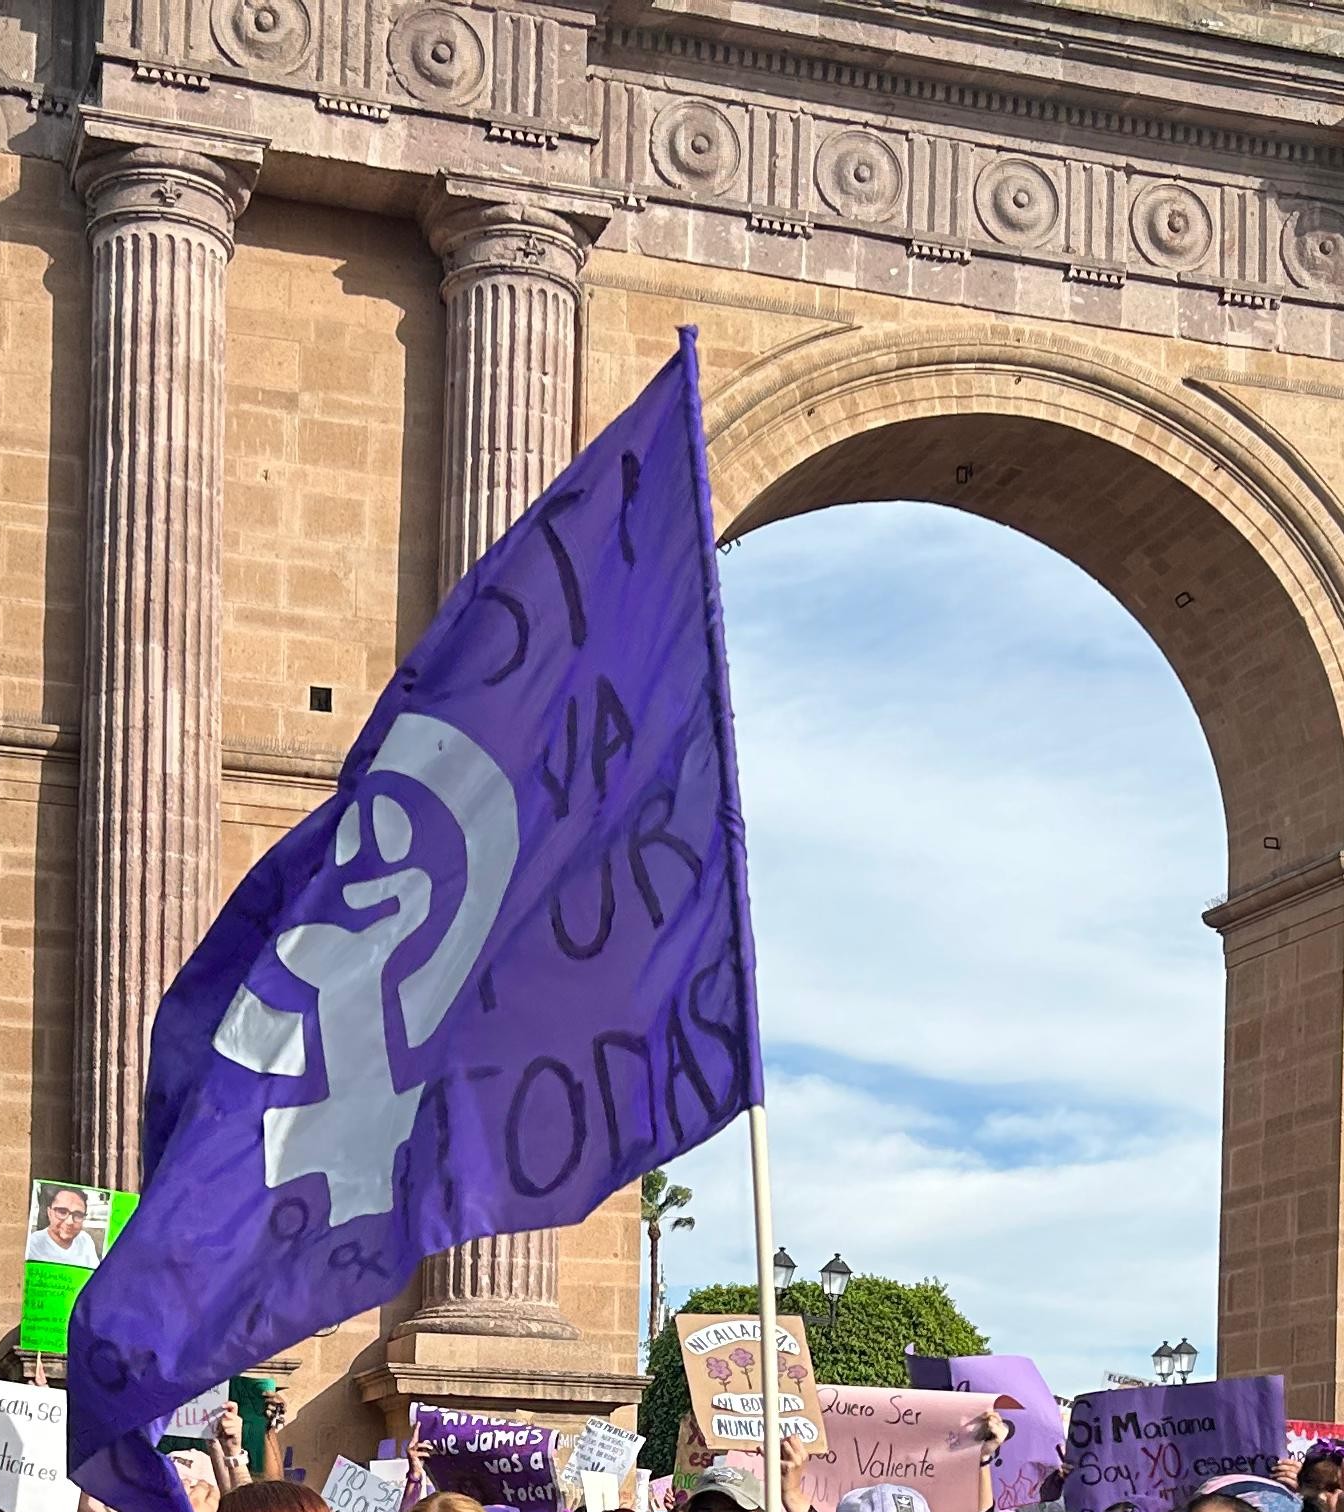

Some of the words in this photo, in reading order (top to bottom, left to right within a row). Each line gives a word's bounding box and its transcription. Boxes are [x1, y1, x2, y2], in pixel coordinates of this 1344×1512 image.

[707, 1322, 799, 1352] CALLADAS
[37, 1402, 62, 1424] se
[741, 1396, 801, 1412] BOAS
[817, 1388, 875, 1417] Quiero
[883, 1395, 922, 1425] Ser
[1070, 1400, 1102, 1448] Si
[1112, 1411, 1215, 1443] Mañana
[466, 1426, 544, 1453] jamás
[484, 1453, 523, 1474] vas
[529, 1451, 545, 1470] a
[853, 1437, 935, 1479] Valiente
[374, 1481, 402, 1511] SA
